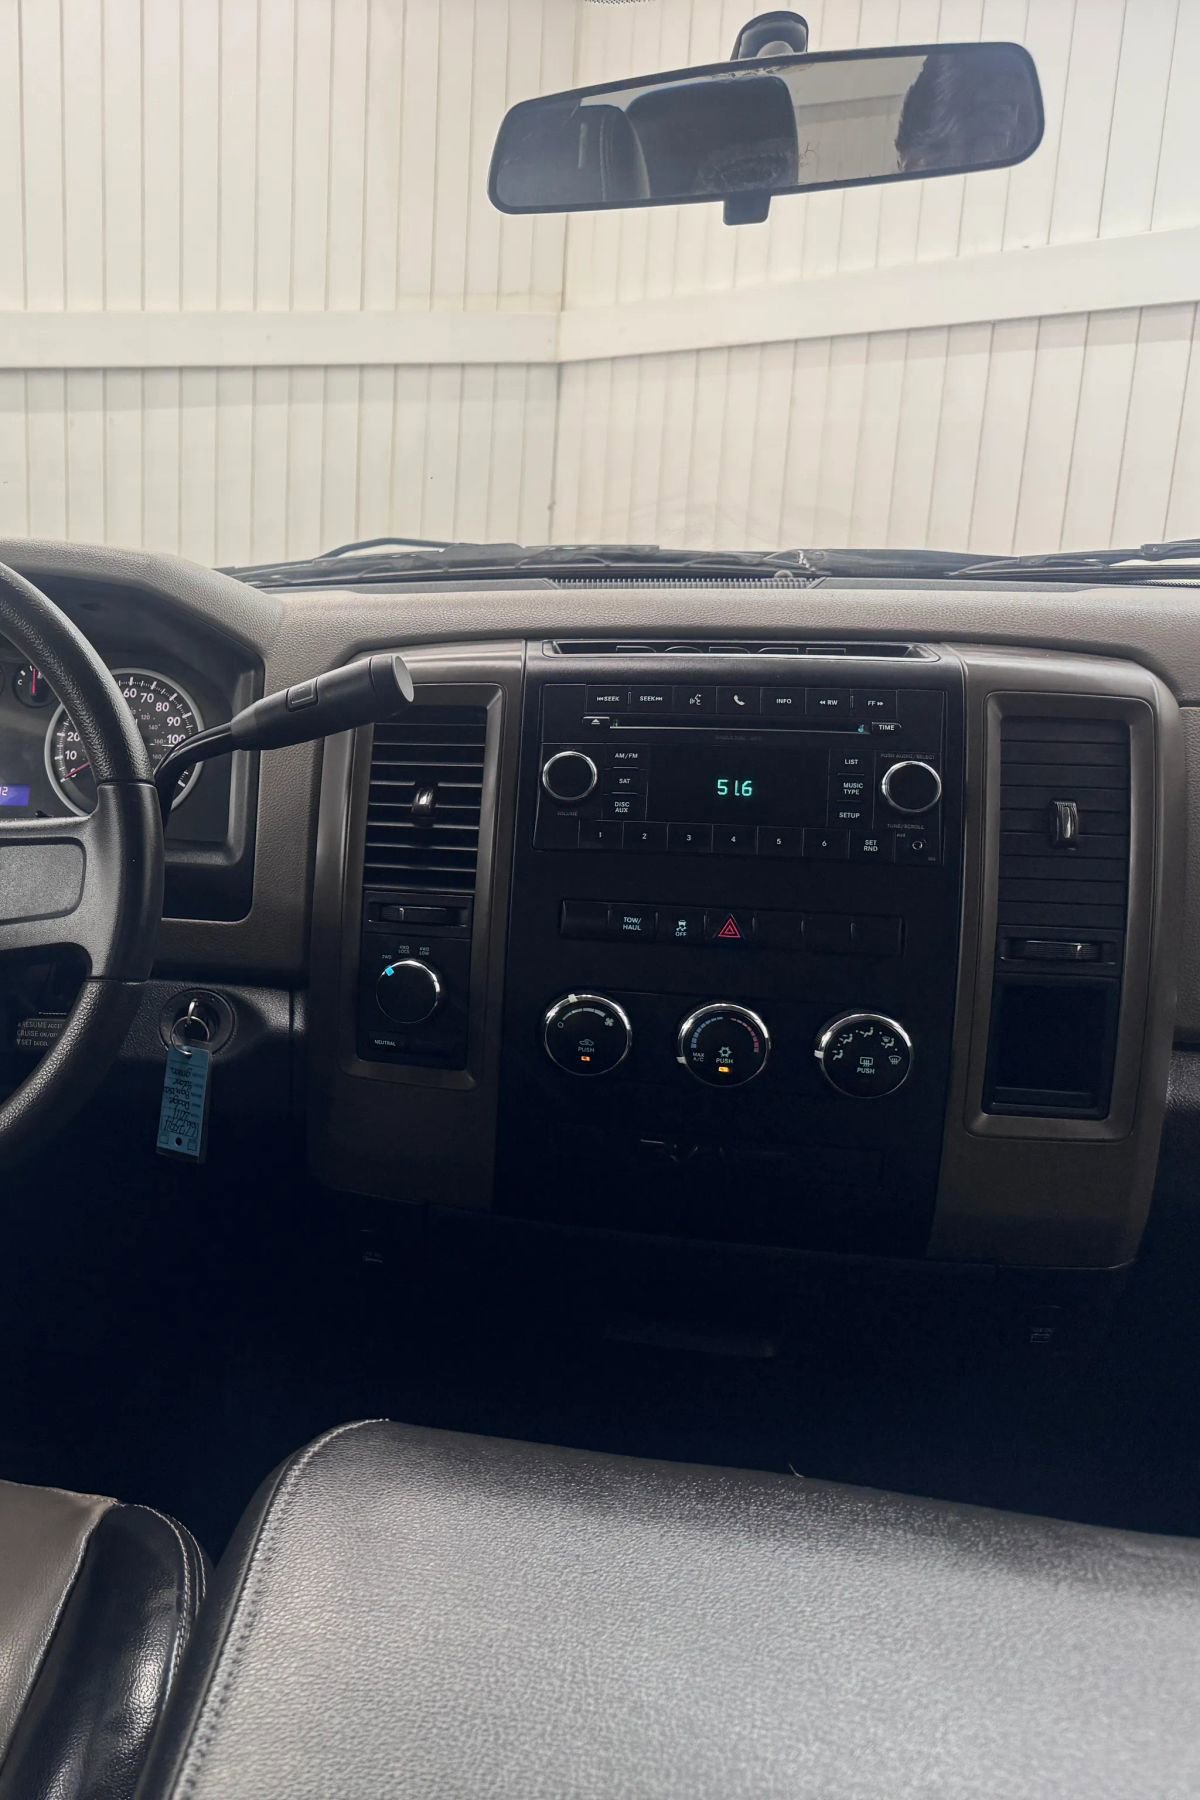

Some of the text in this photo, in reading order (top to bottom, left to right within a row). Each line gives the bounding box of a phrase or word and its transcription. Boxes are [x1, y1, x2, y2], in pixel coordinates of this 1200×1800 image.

[123, 688, 137, 699] 60
[140, 693, 155, 703] 70
[155, 702, 170, 712] 80
[166, 716, 181, 727] 90
[67, 731, 80, 742] 20
[65, 750, 77, 760] 10
[614, 752, 639, 760] AM/FM
[623, 916, 641, 924] TOW/
